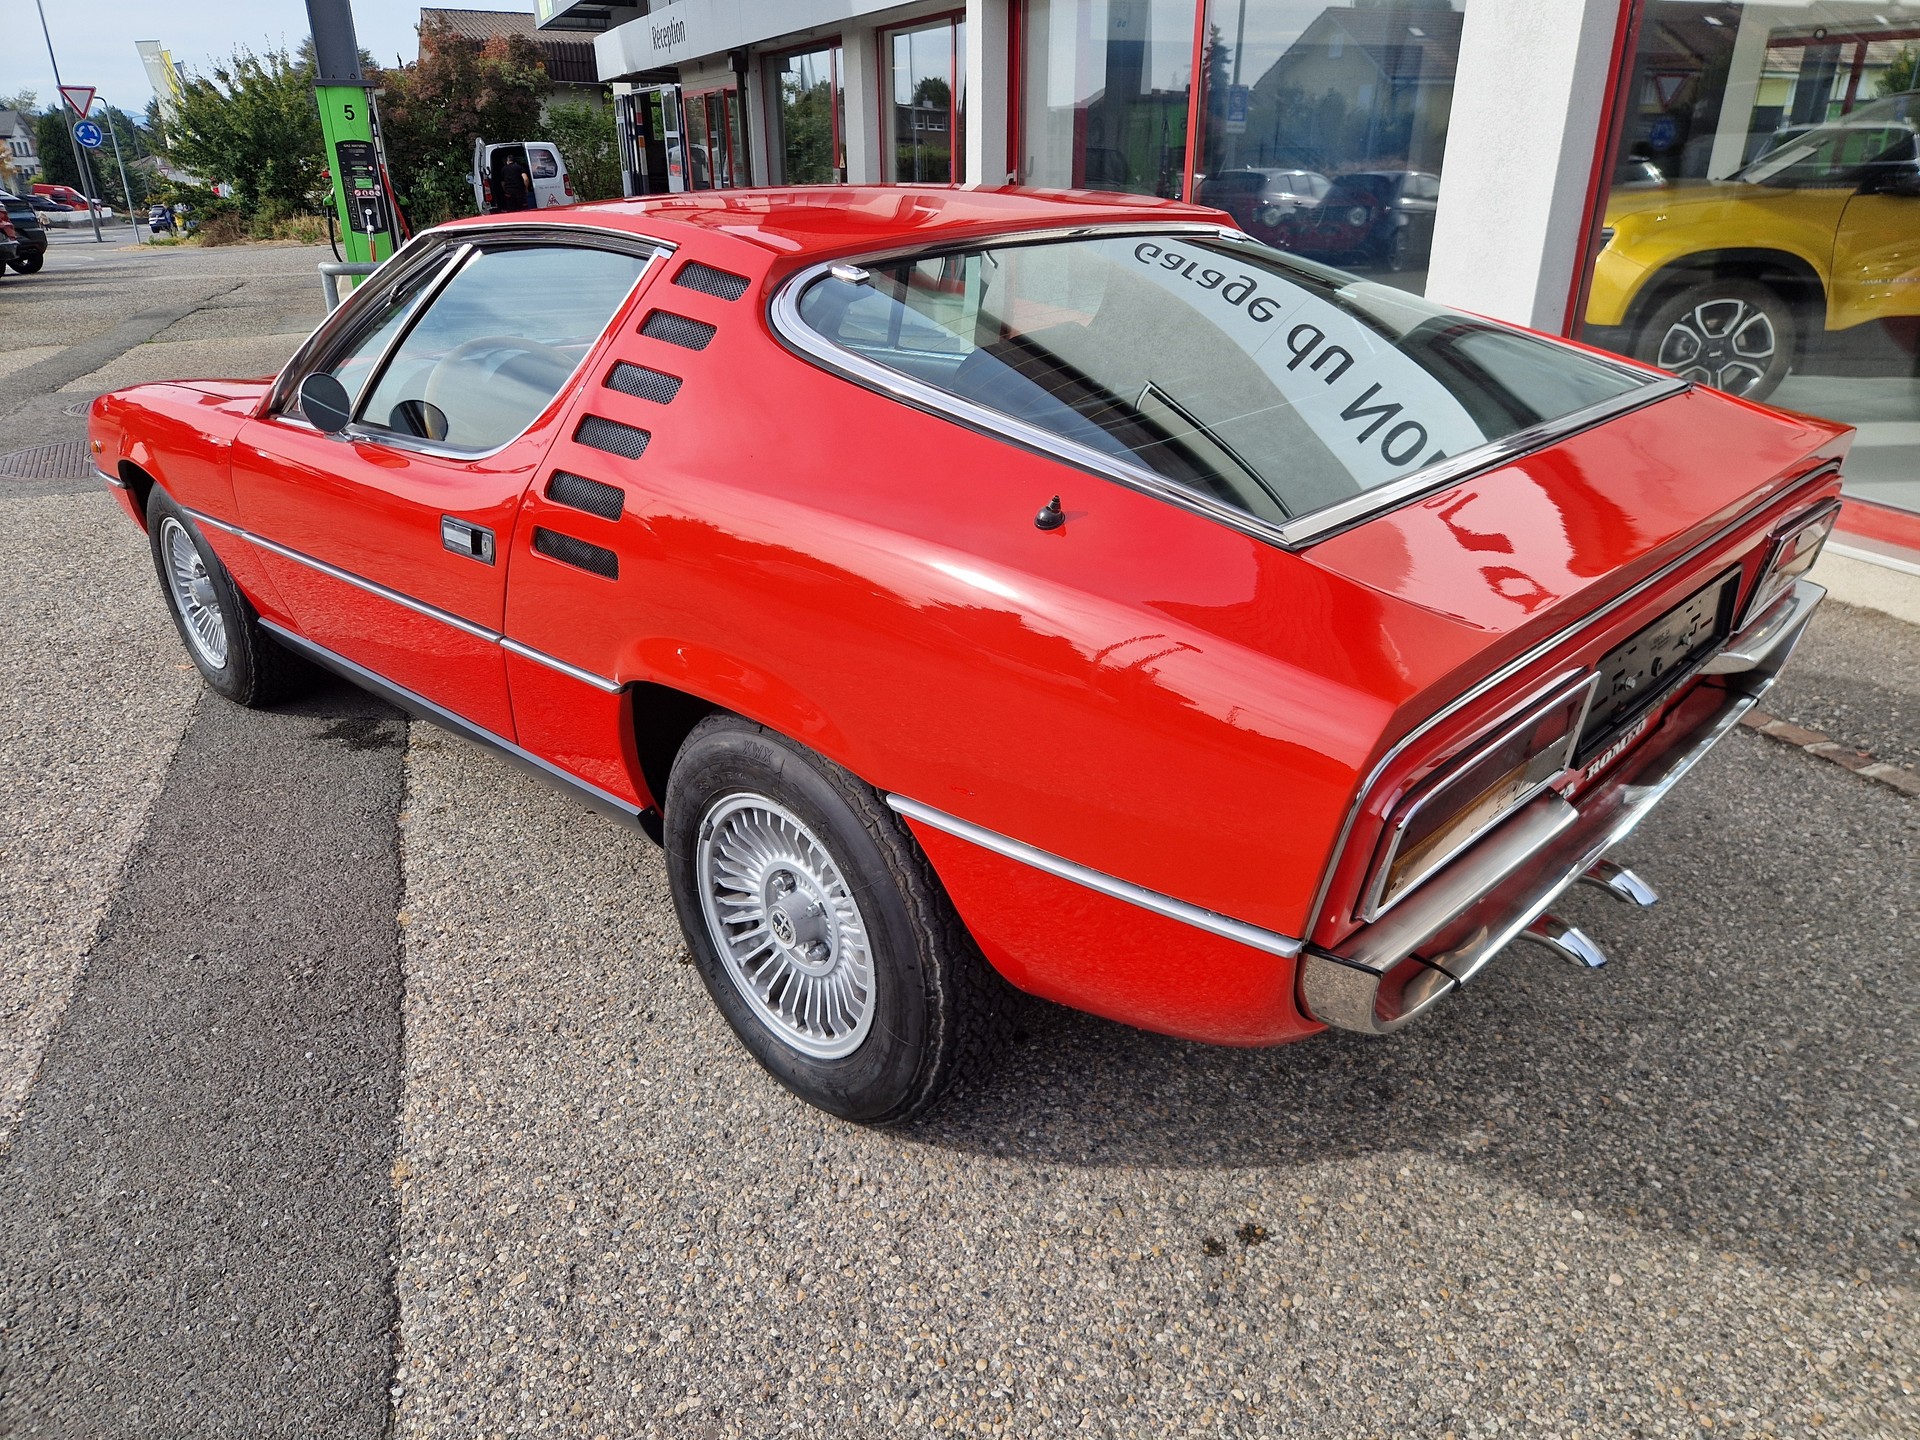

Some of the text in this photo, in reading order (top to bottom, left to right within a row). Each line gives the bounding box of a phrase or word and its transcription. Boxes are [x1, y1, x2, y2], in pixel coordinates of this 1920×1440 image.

[651, 16, 686, 54] Réception
[344, 104, 355, 121] 5
[742, 740, 775, 764] XWX
[1585, 718, 1648, 782] ROMEO
